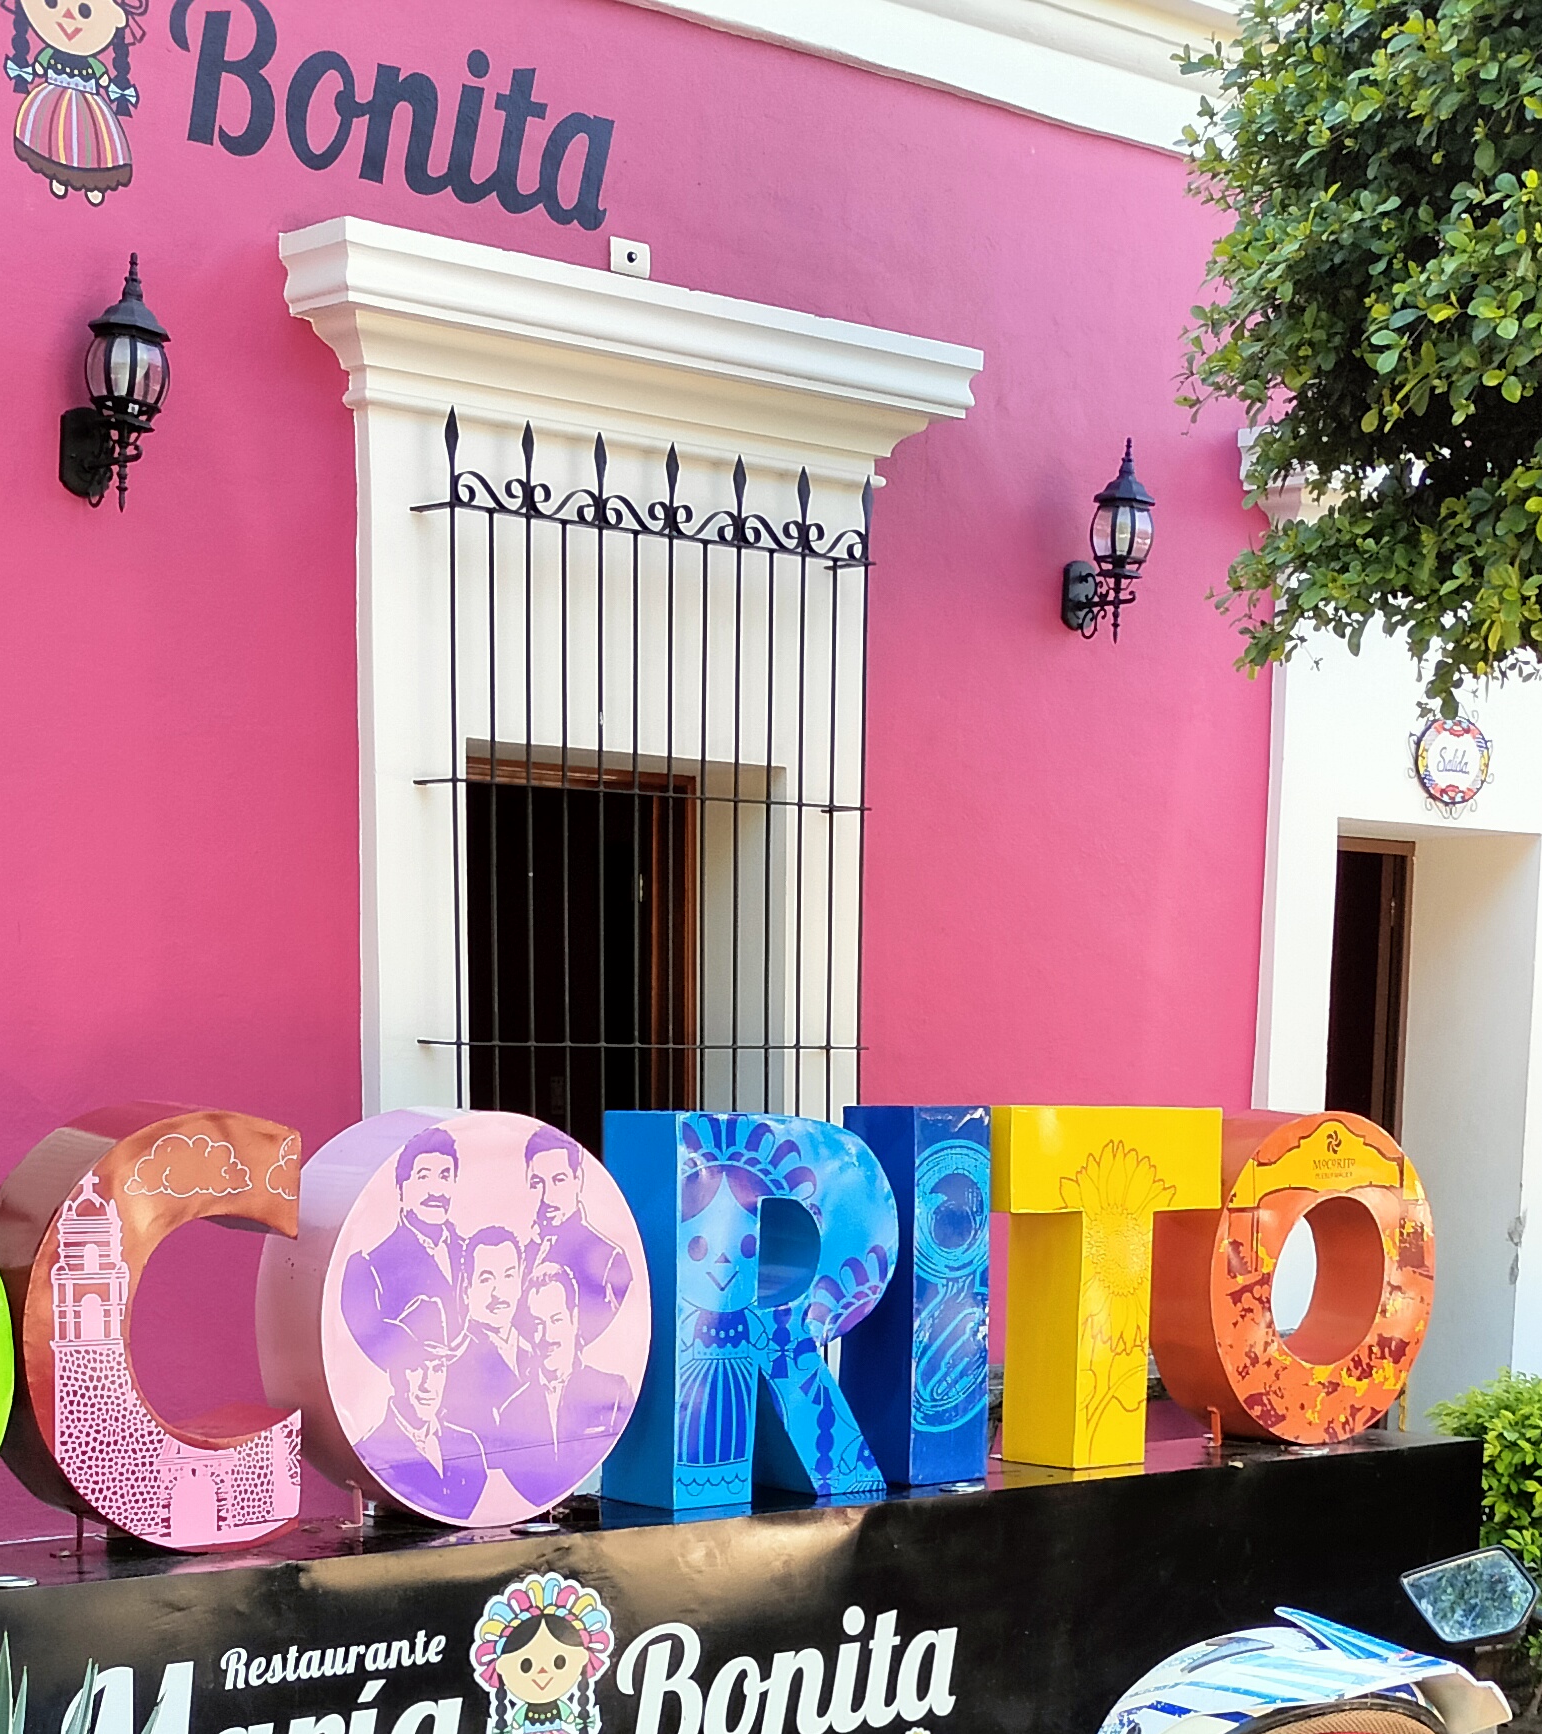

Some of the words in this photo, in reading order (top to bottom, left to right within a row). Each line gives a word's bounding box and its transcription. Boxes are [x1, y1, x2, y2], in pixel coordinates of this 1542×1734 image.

[170, 0, 615, 231] Bonita
[1436, 746, 1469, 774] Salida
[220, 1628, 448, 1691] Restaurante
